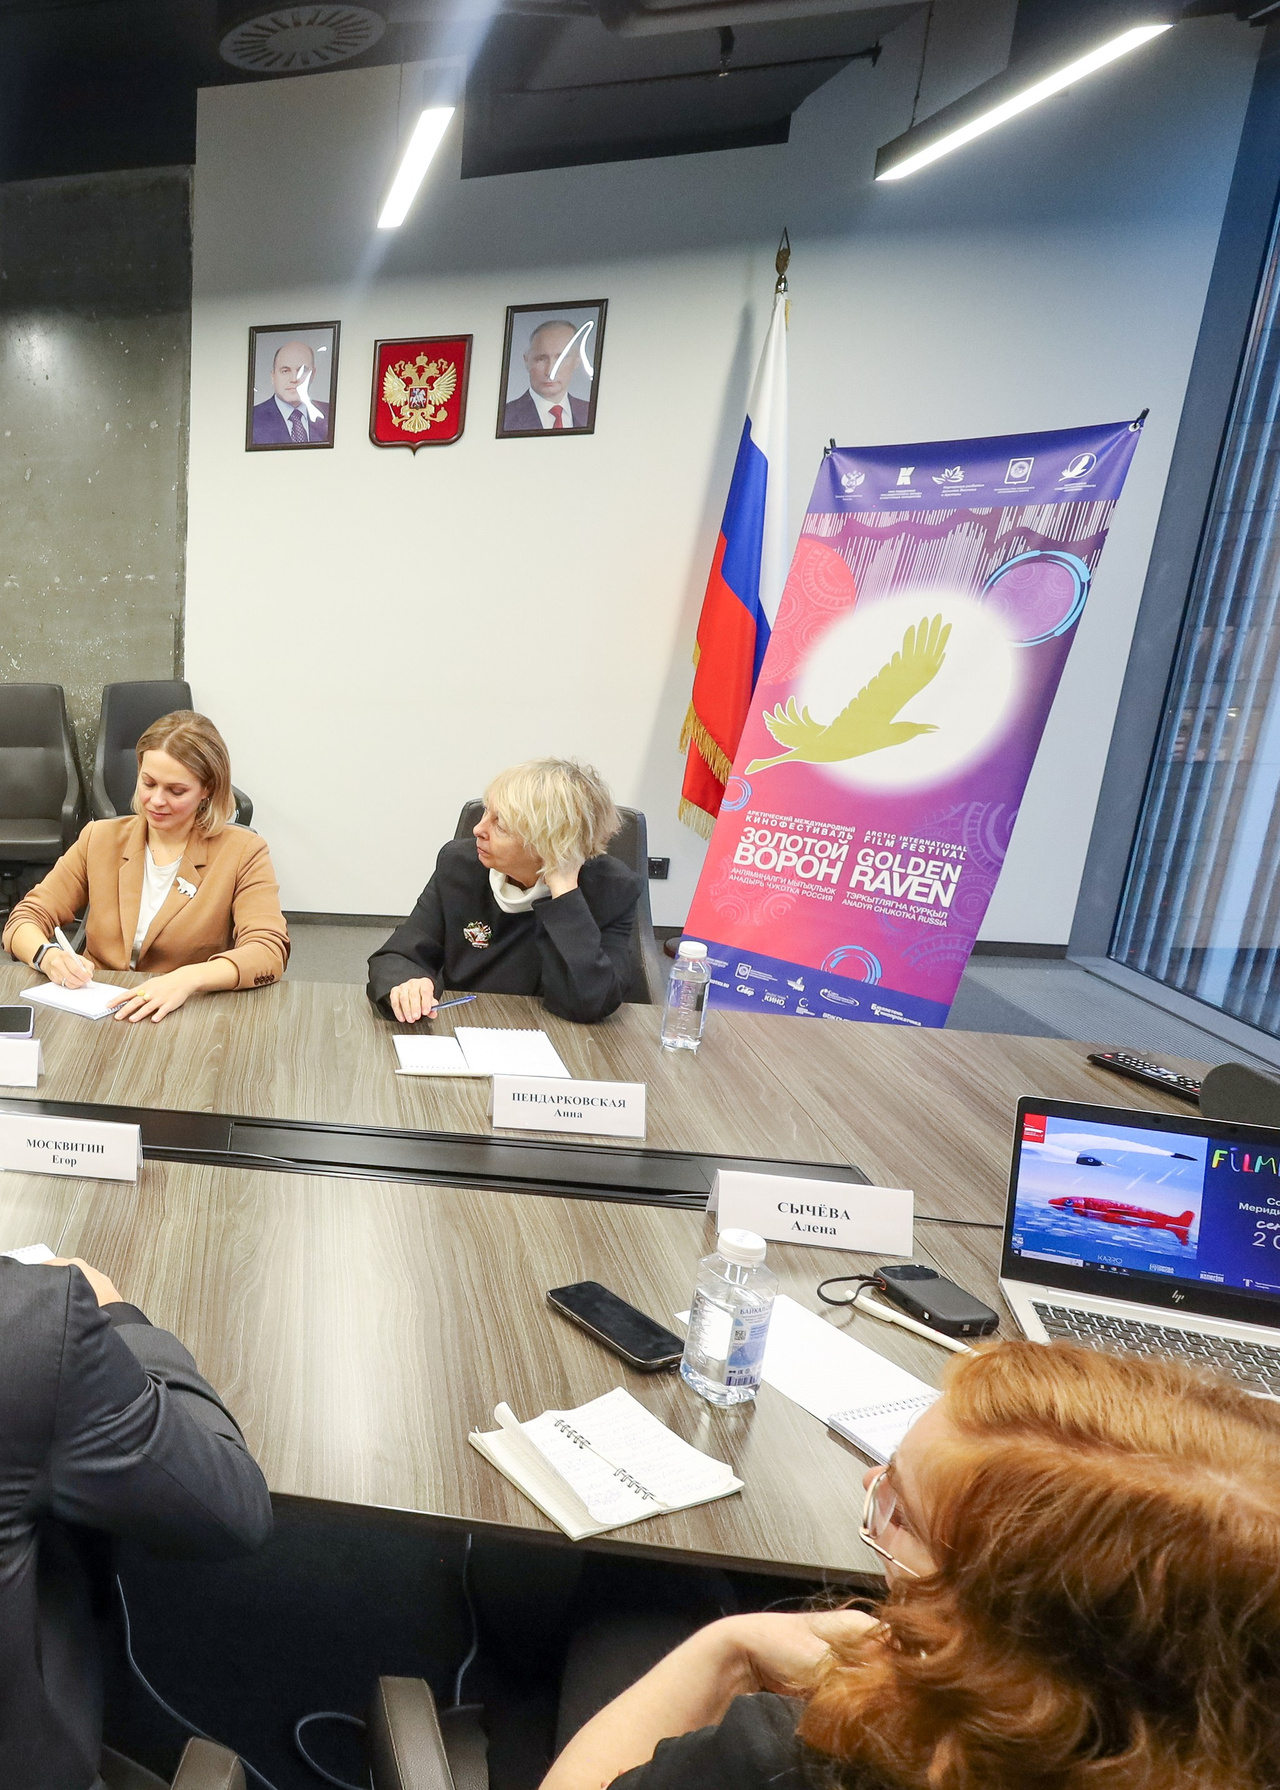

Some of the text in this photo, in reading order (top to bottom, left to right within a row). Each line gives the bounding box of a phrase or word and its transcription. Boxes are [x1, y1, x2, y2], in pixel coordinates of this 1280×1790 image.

[745, 815, 854, 840] КИНОФЕСТИВАЛЬ
[747, 809, 856, 833] АРКТИЧЕСКИЙ МЕЖДУНАРОДНЫЙ
[740, 826, 850, 862] ЗОЛОТОЙ
[863, 836, 966, 860] FILM FESTIVAL
[865, 830, 968, 852] ARCTIC INTERNATIONAL
[733, 842, 844, 884] ВОРОН
[856, 848, 963, 883] GOLDEN
[728, 874, 834, 902] АНАДЫРЬ ЧУКОТКА РОССИЯ
[849, 864, 957, 908] RAVEN
[841, 899, 948, 928] ANADYR CHUKOTKA RUSSIA
[763, 994, 785, 1006] КИНО
[512, 1092, 627, 1108] ПЕНДАРКОВСКАЯ
[554, 1109, 583, 1119] Анна
[26, 1139, 105, 1154] МОСКВИТИН
[52, 1154, 77, 1167] Егор
[777, 1201, 851, 1221] СЫЧЁВА
[791, 1220, 837, 1235] Алена
